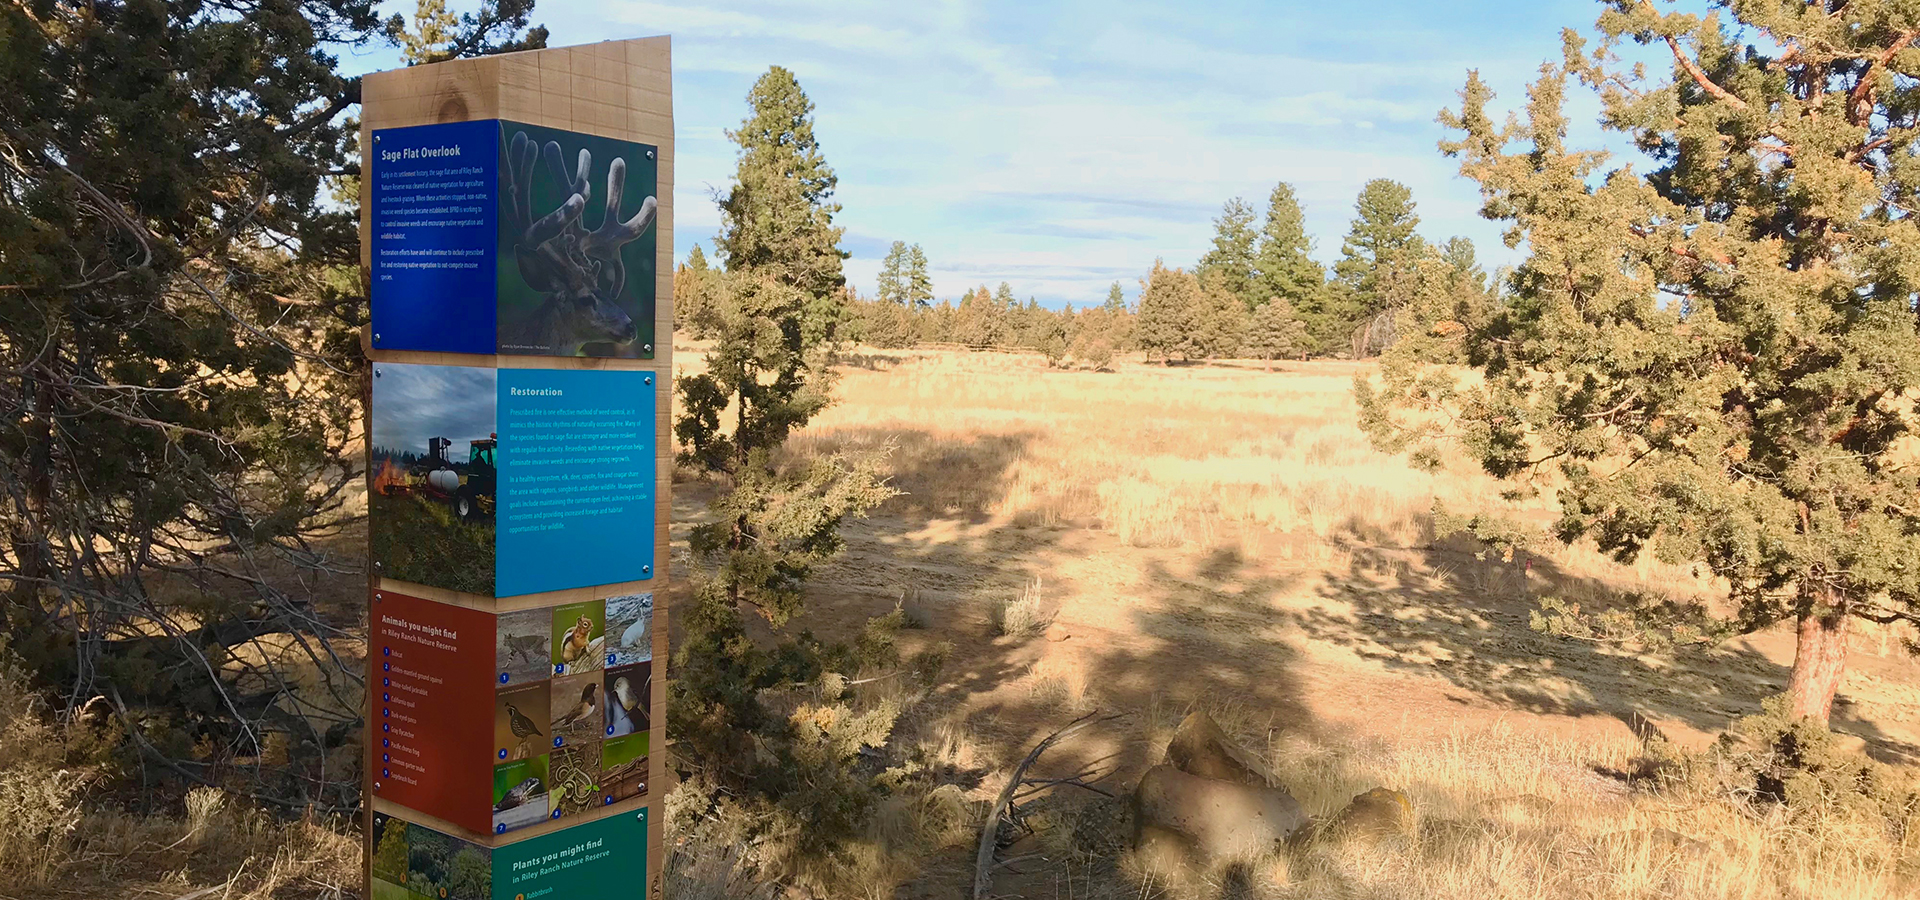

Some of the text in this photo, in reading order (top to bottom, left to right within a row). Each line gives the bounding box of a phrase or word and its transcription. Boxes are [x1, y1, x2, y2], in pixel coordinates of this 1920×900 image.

[382, 144, 460, 162] Sage Flat Overlook
[462, 167, 472, 175] Riley
[393, 261, 408, 270] restoring
[419, 262, 437, 270] vegetation
[511, 387, 563, 396] Restoration
[553, 421, 571, 429] rhythms
[577, 420, 596, 428] naturally
[625, 420, 636, 428] Many
[518, 434, 535, 442] species
[581, 432, 600, 440] stronger
[521, 446, 538, 455] regular
[564, 444, 587, 453] Reseeding
[611, 443, 633, 452] vegetation
[634, 443, 645, 451] helps
[596, 456, 610, 464] strong
[509, 524, 540, 534] opportunities
[382, 614, 457, 640] Animals you might find
[388, 629, 400, 639] Riley
[401, 632, 416, 642] Ranch
[417, 636, 435, 647] Nature
[436, 641, 457, 653] Reserve
[391, 650, 403, 658] Bobcat
[391, 741, 401, 750] Pacific
[391, 756, 405, 766] Common
[416, 765, 425, 773] snake
[512, 838, 602, 871] Plants you might find
[522, 872, 538, 881] Riley
[540, 864, 560, 876] Ranch
[561, 858, 583, 869] Nature
[585, 850, 610, 862] Reserve
[527, 886, 553, 899] Rabbitbrush
